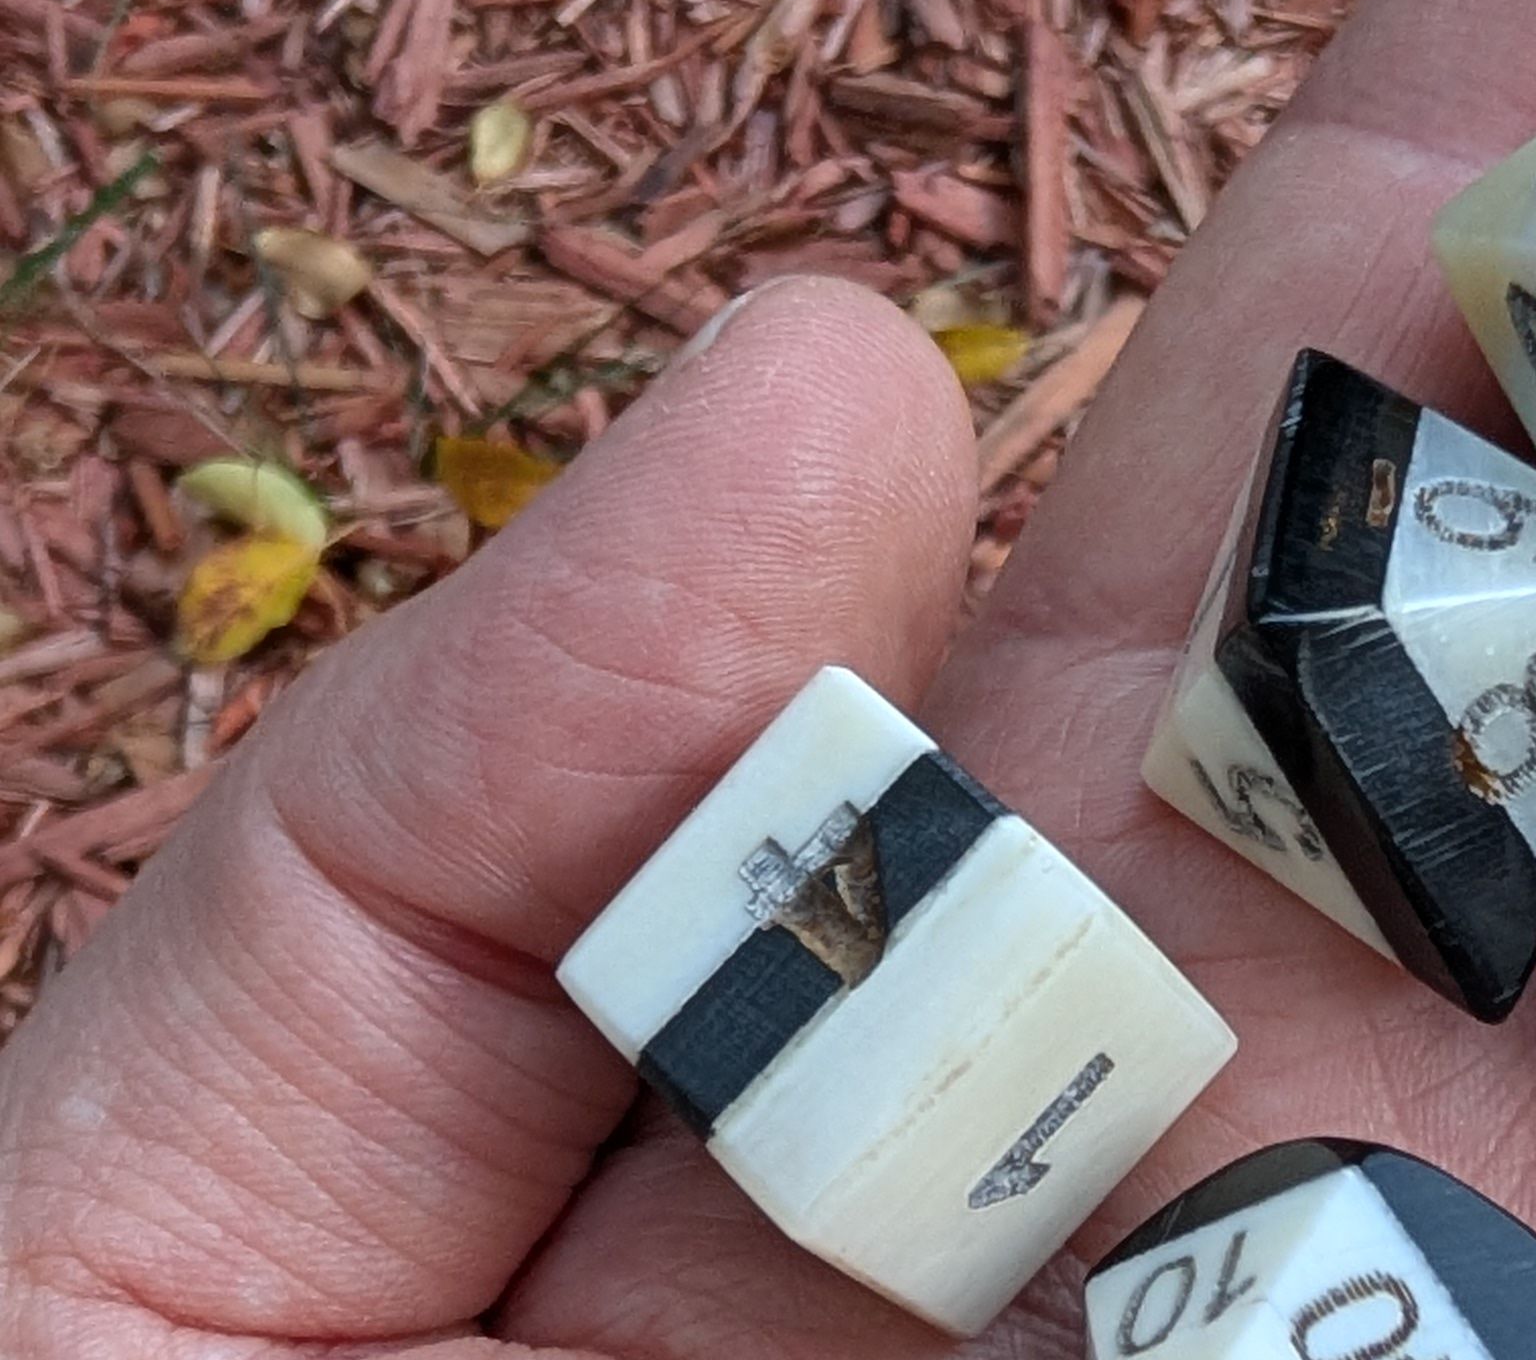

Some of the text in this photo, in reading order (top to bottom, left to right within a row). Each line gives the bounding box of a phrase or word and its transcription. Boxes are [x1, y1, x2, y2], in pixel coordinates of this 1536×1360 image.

[737, 800, 886, 990] 4
[967, 1051, 1116, 1210] 1
[1117, 1230, 1258, 1358] 10
